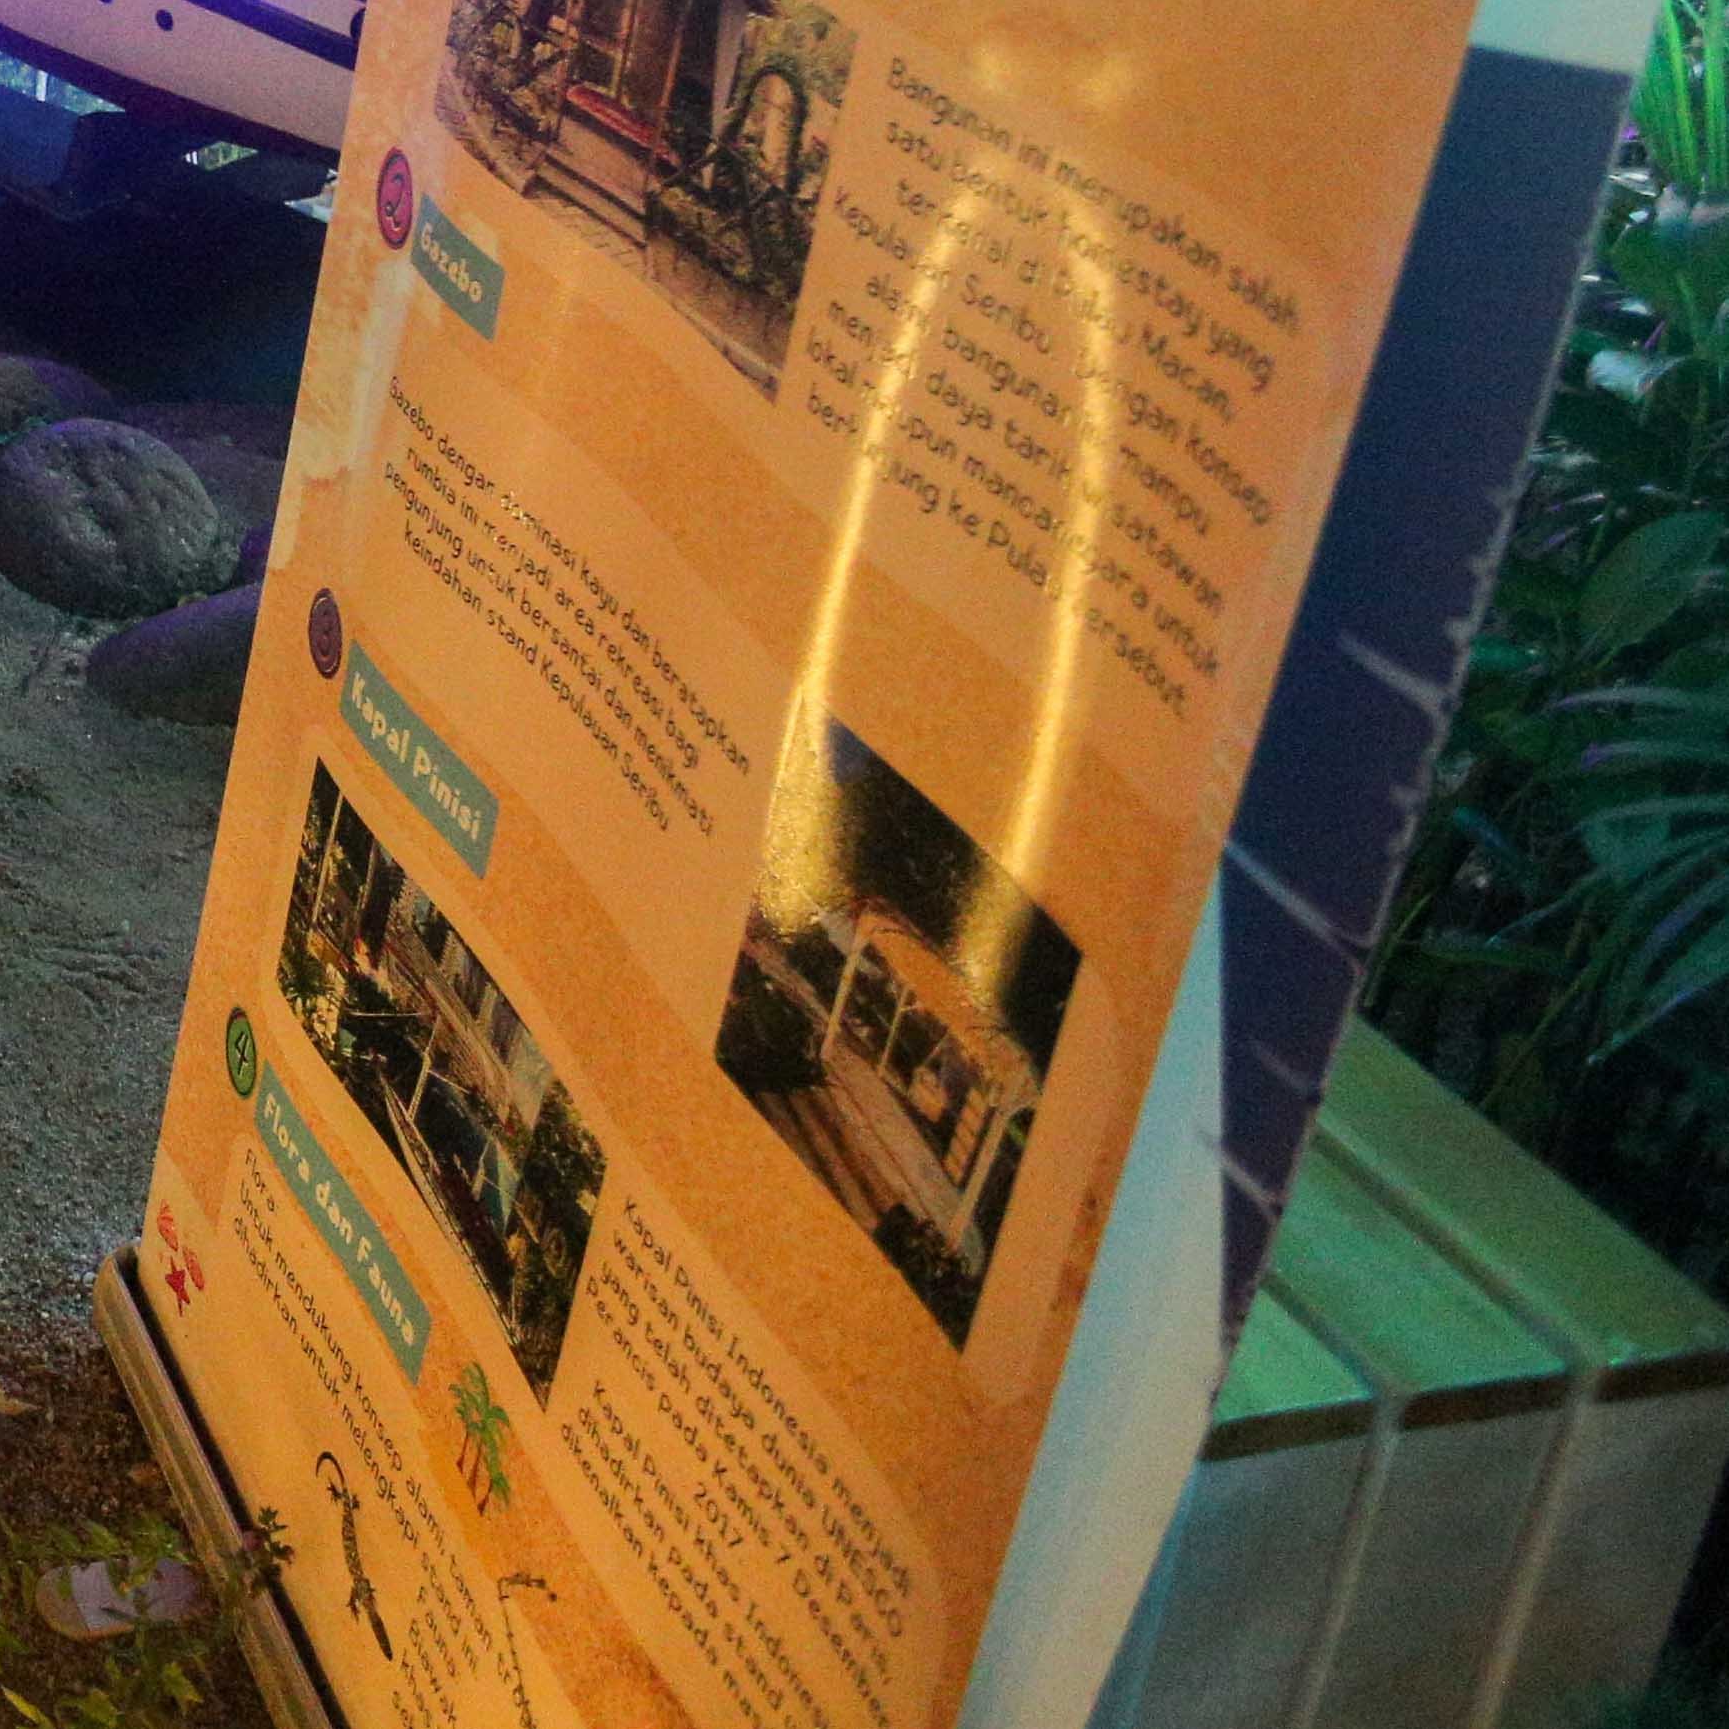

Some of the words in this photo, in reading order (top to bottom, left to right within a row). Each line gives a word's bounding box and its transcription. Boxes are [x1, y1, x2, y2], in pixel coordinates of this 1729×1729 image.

[419, 221, 483, 304] Gazebo
[886, 57, 1012, 151] Bangunan
[1015, 135, 1053, 170] ini
[1227, 263, 1301, 336] salah
[886, 121, 945, 172] satu
[1208, 318, 1277, 397] yang
[926, 372, 994, 432] daya
[947, 489, 981, 536] ke
[1186, 435, 1271, 526] konsep
[384, 463, 464, 560] pengunjung
[520, 586, 602, 691] bersantai
[604, 684, 634, 726] dan
[404, 518, 482, 615] keindahan
[486, 607, 540, 665] stand
[541, 656, 621, 761] Kepulauan
[406, 447, 456, 505] rumbia
[460, 499, 480, 527] ini
[555, 586, 596, 637] area
[664, 716, 701, 770] bagi
[437, 434, 496, 493] dengan
[581, 556, 620, 615] kayu
[622, 608, 651, 650] dan
[651, 640, 752, 777] beratapkan
[1153, 604, 1220, 682] untuk
[351, 671, 410, 765] Kapal
[413, 750, 481, 843] Pinisi
[263, 1092, 311, 1185] Flora
[315, 1181, 355, 1245] dan
[356, 1235, 416, 1347] Fauna
[623, 1198, 673, 1271] Kapal
[674, 1263, 724, 1342] Pinisi
[726, 1334, 833, 1476] Indonesia
[234, 1216, 299, 1337] dihadirkan
[299, 1336, 341, 1405] untuk
[341, 1401, 422, 1549] melengkapi
[275, 1248, 354, 1385] mendukung
[354, 1377, 404, 1474] konsep
[601, 1261, 640, 1326] yang
[644, 1318, 691, 1396] telah
[694, 1390, 810, 1552] ditetapkan
[814, 1551, 832, 1587] di
[612, 1231, 681, 1332] warisan
[682, 1327, 756, 1432] budaya
[759, 1429, 818, 1510] dunia
[658, 1393, 709, 1463] pada
[711, 1458, 774, 1549] Kamis
[560, 1422, 645, 1559] dikenalkan
[646, 1553, 718, 1668] kepada
[577, 1405, 666, 1540] dihadirkan
[668, 1547, 720, 1620] pada
[723, 1620, 784, 1711] stand
[591, 1380, 641, 1462] Kapal
[643, 1453, 691, 1530] Pinisi
[692, 1522, 741, 1602] khas
[693, 1482, 745, 1549] 2017
